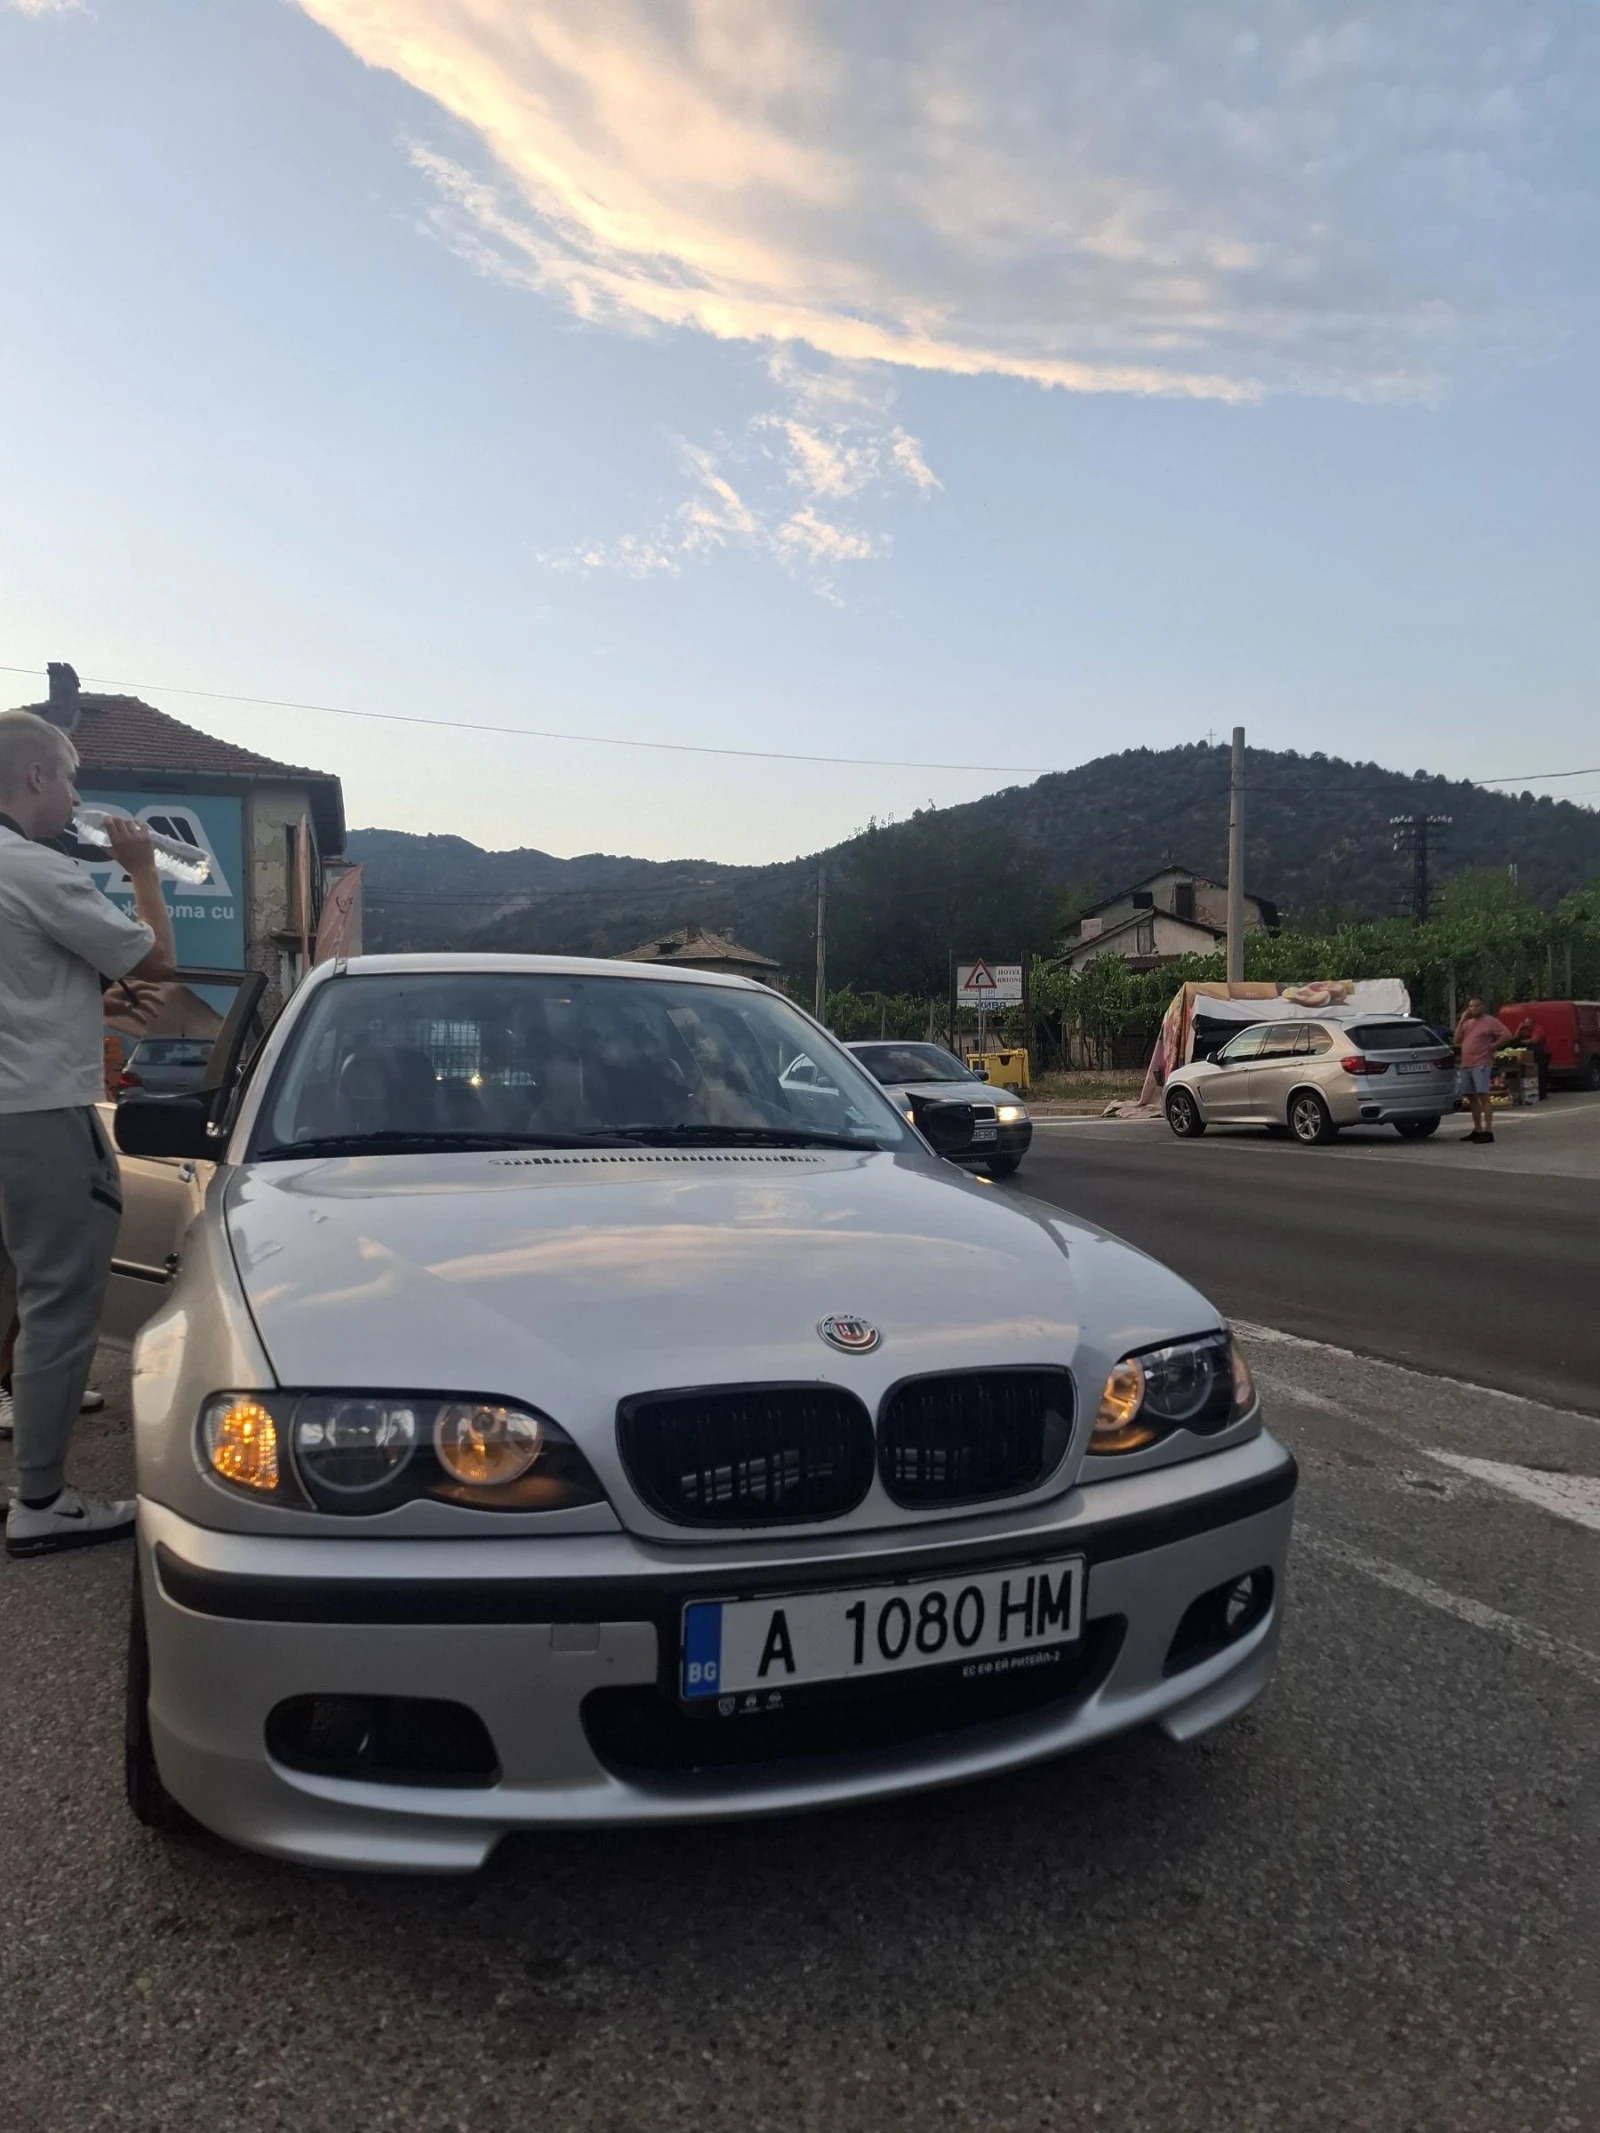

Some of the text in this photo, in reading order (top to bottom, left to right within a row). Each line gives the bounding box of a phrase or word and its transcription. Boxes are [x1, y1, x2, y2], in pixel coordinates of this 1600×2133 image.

[757, 1570, 1073, 1678] A 1080 HM
[687, 1661, 717, 1684] BG
